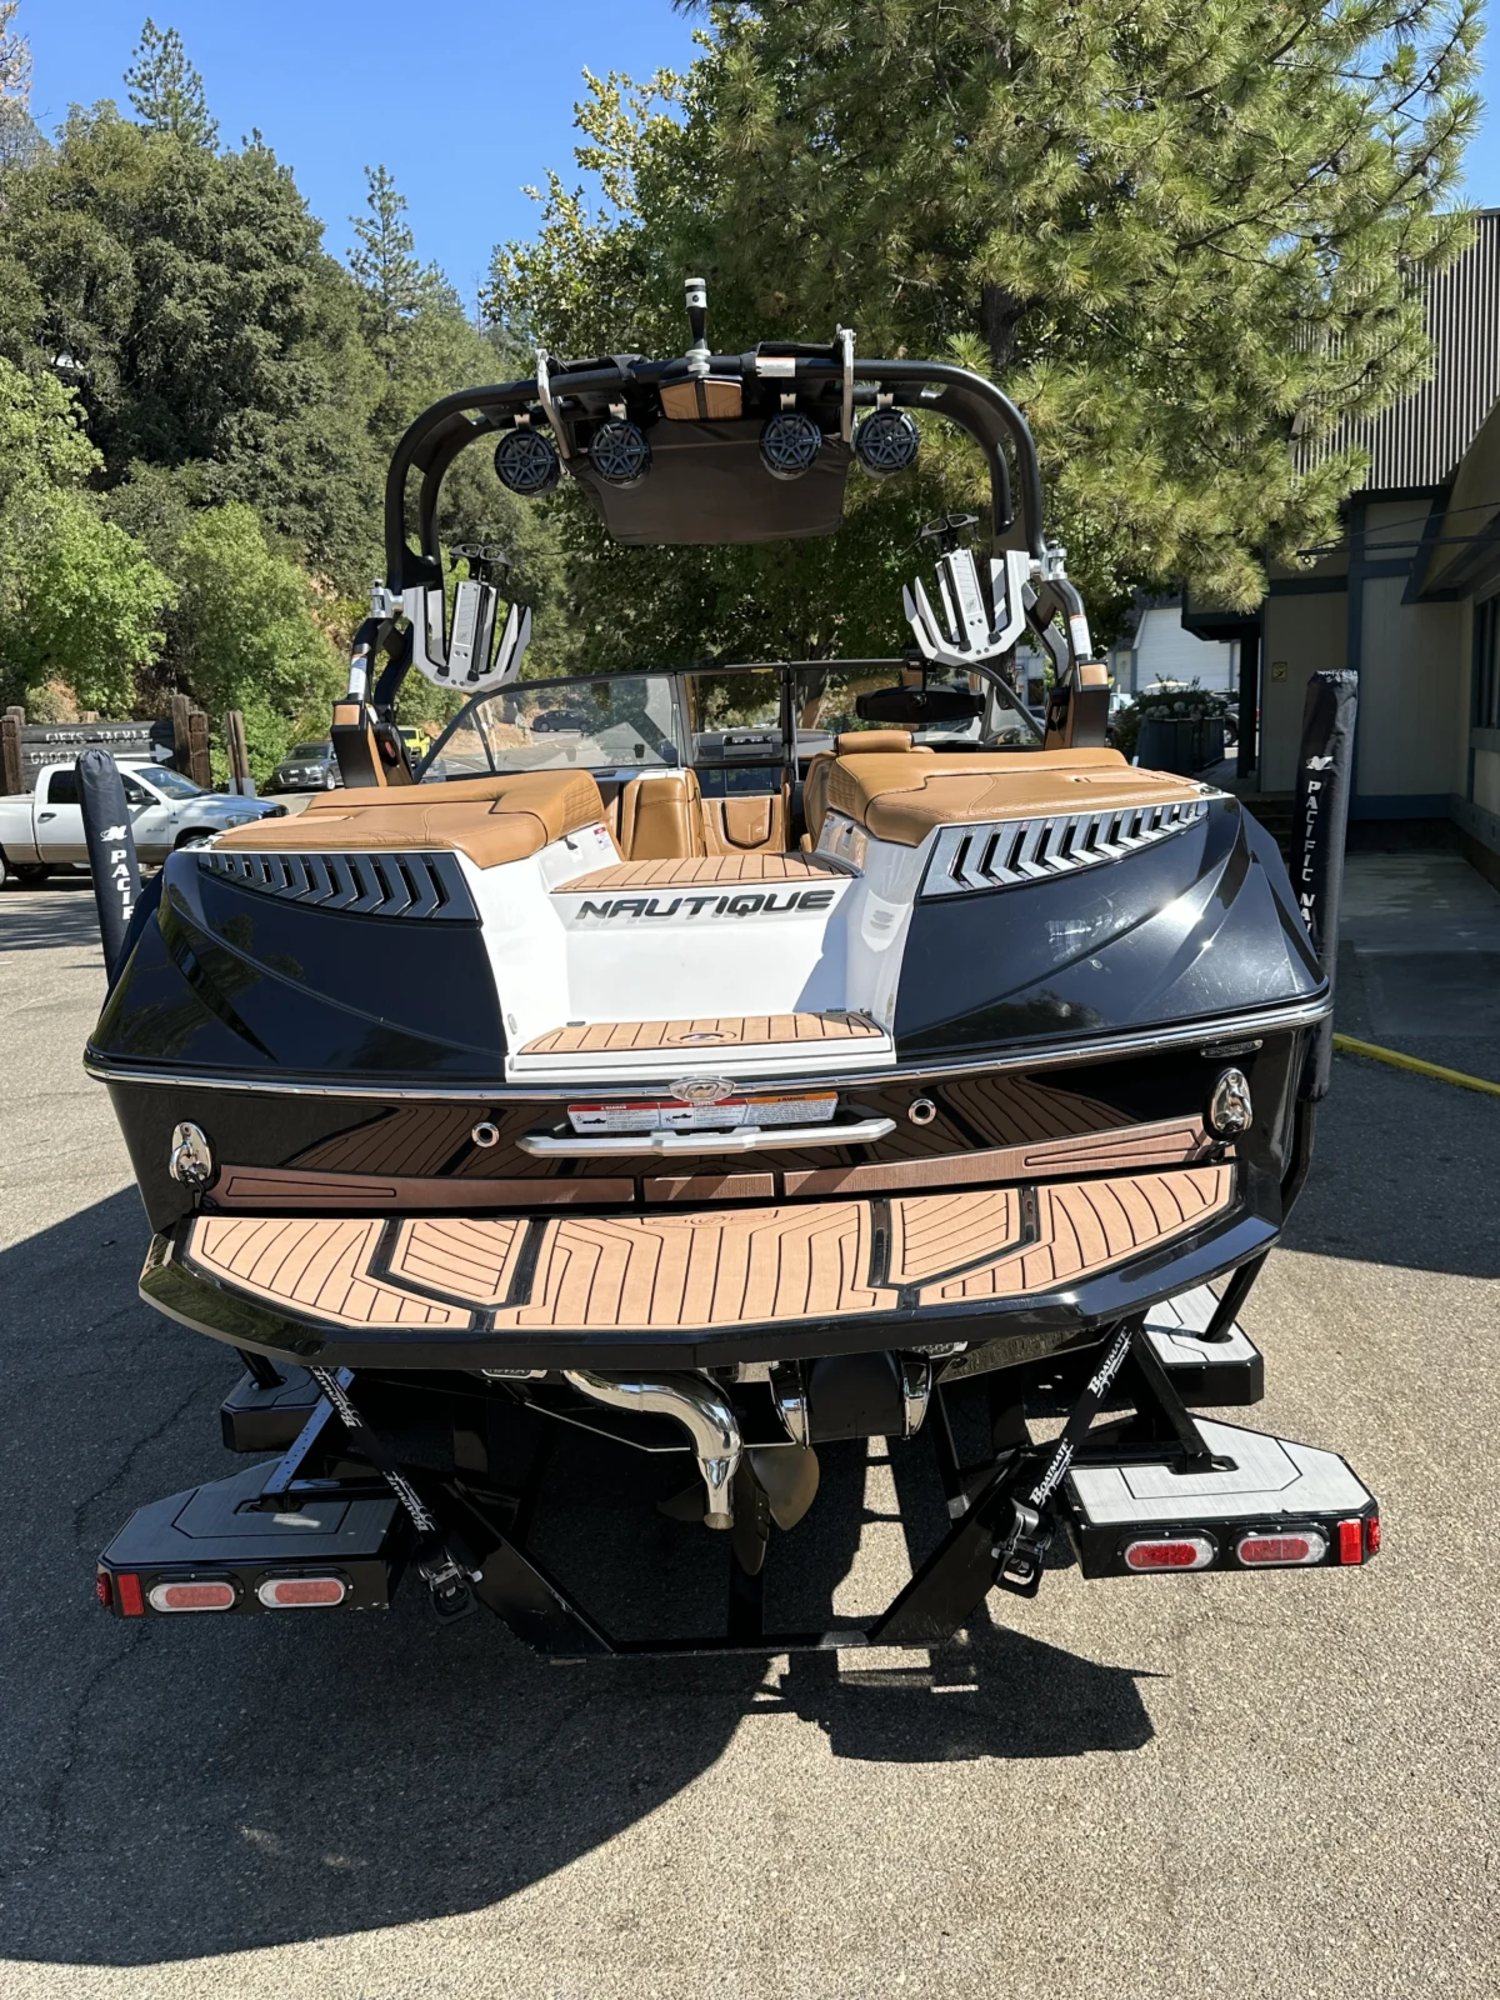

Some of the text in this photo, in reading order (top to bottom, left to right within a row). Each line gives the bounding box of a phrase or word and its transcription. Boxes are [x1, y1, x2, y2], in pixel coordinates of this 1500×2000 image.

[1302, 780, 1322, 882] PACIFIC
[575, 890, 836, 920] NAUTIQUE
[1087, 1328, 1127, 1394] BOATMATE
[1028, 1440, 1069, 1505] BOATMATE
